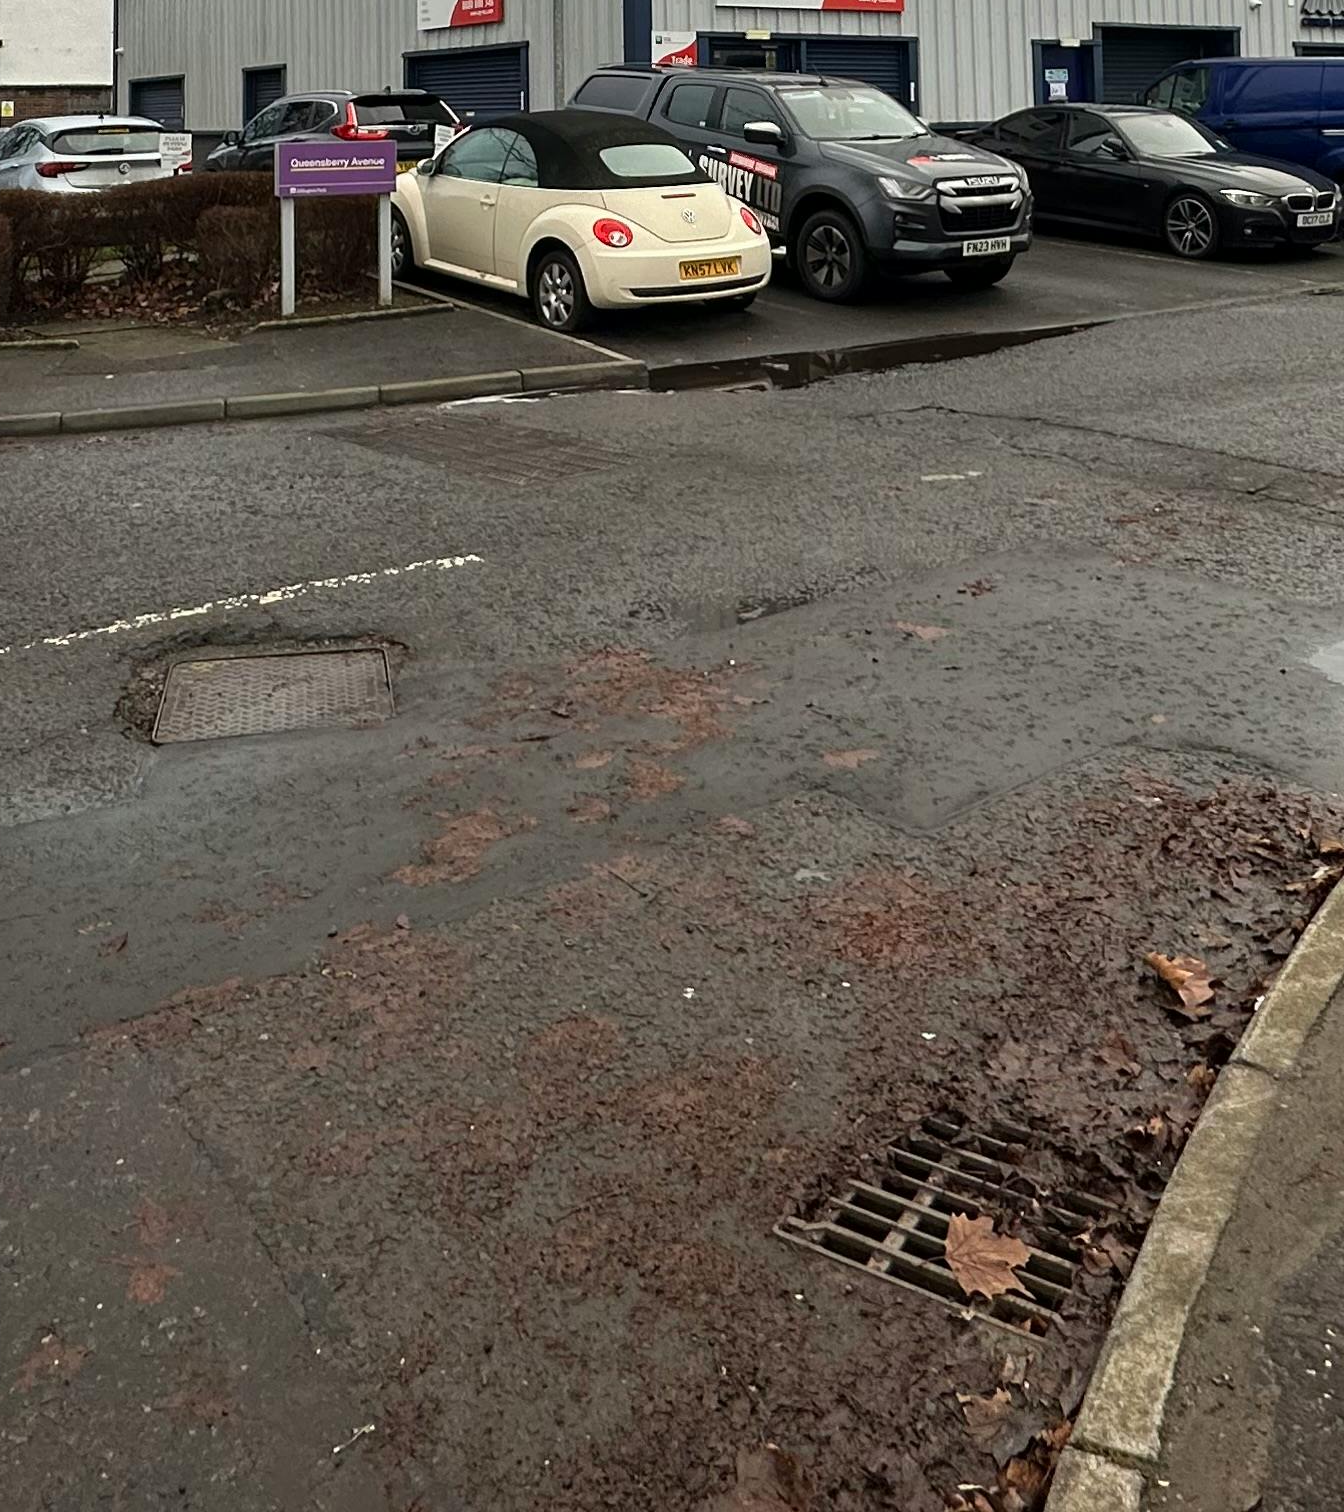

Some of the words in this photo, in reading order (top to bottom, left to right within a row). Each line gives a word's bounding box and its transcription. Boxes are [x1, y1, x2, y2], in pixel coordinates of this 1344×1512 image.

[290, 158, 349, 168] Queensberry
[351, 157, 385, 166] Avenue
[698, 154, 754, 202] SURVEY
[756, 175, 782, 213] LTD
[966, 175, 1000, 186] ISUZU
[966, 240, 990, 254] FN23
[683, 263, 711, 277] KN57
[713, 260, 735, 274] LVK
